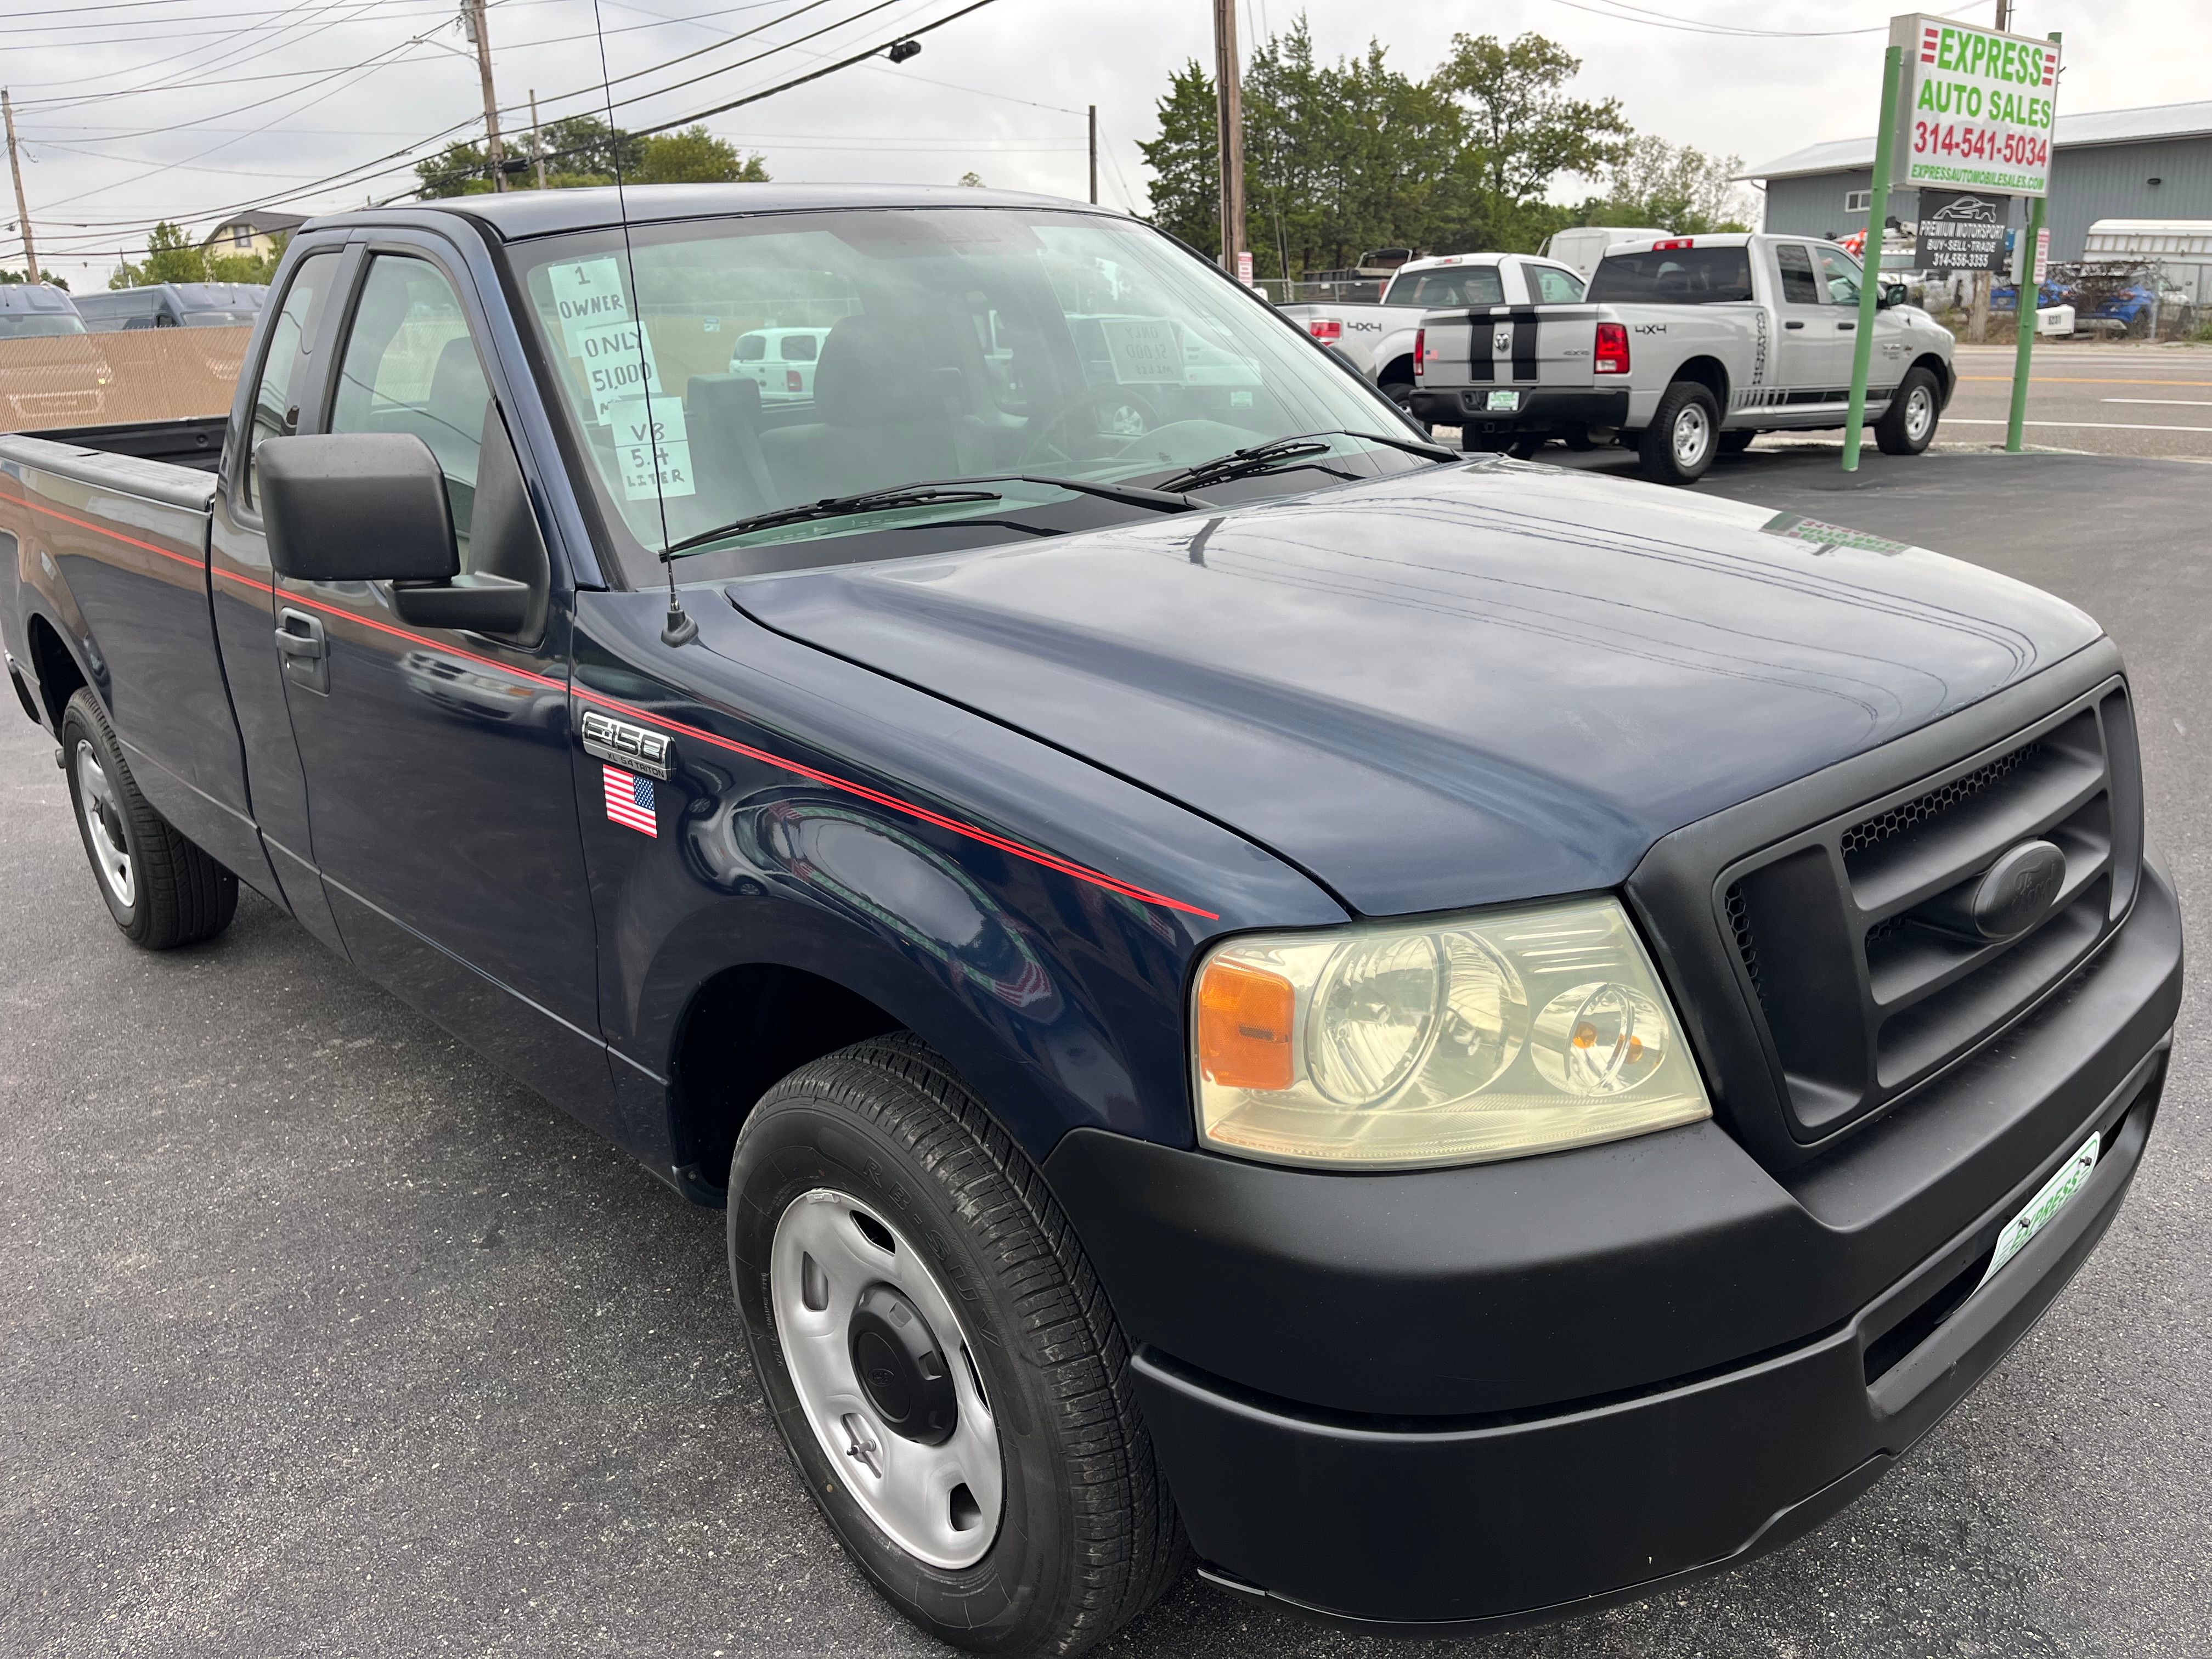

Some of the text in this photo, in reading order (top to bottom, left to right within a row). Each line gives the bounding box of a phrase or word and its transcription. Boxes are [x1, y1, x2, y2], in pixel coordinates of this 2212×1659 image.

[1937, 28, 2043, 87] EXPRESS
[1917, 79, 2051, 129] AUTO SALES
[1914, 121, 2047, 167] 314-541-5034
[1911, 164, 2045, 190] EXPRESSAUTOMOBILESALES.COM
[1919, 220, 2006, 240] PREMIUM MOTORSPORT
[574, 266, 591, 285] 1
[559, 294, 624, 319] OWNER
[585, 329, 644, 358] ONLY
[627, 469, 685, 487] LITER
[607, 752, 618, 762] XL
[634, 761, 664, 778] TRITON
